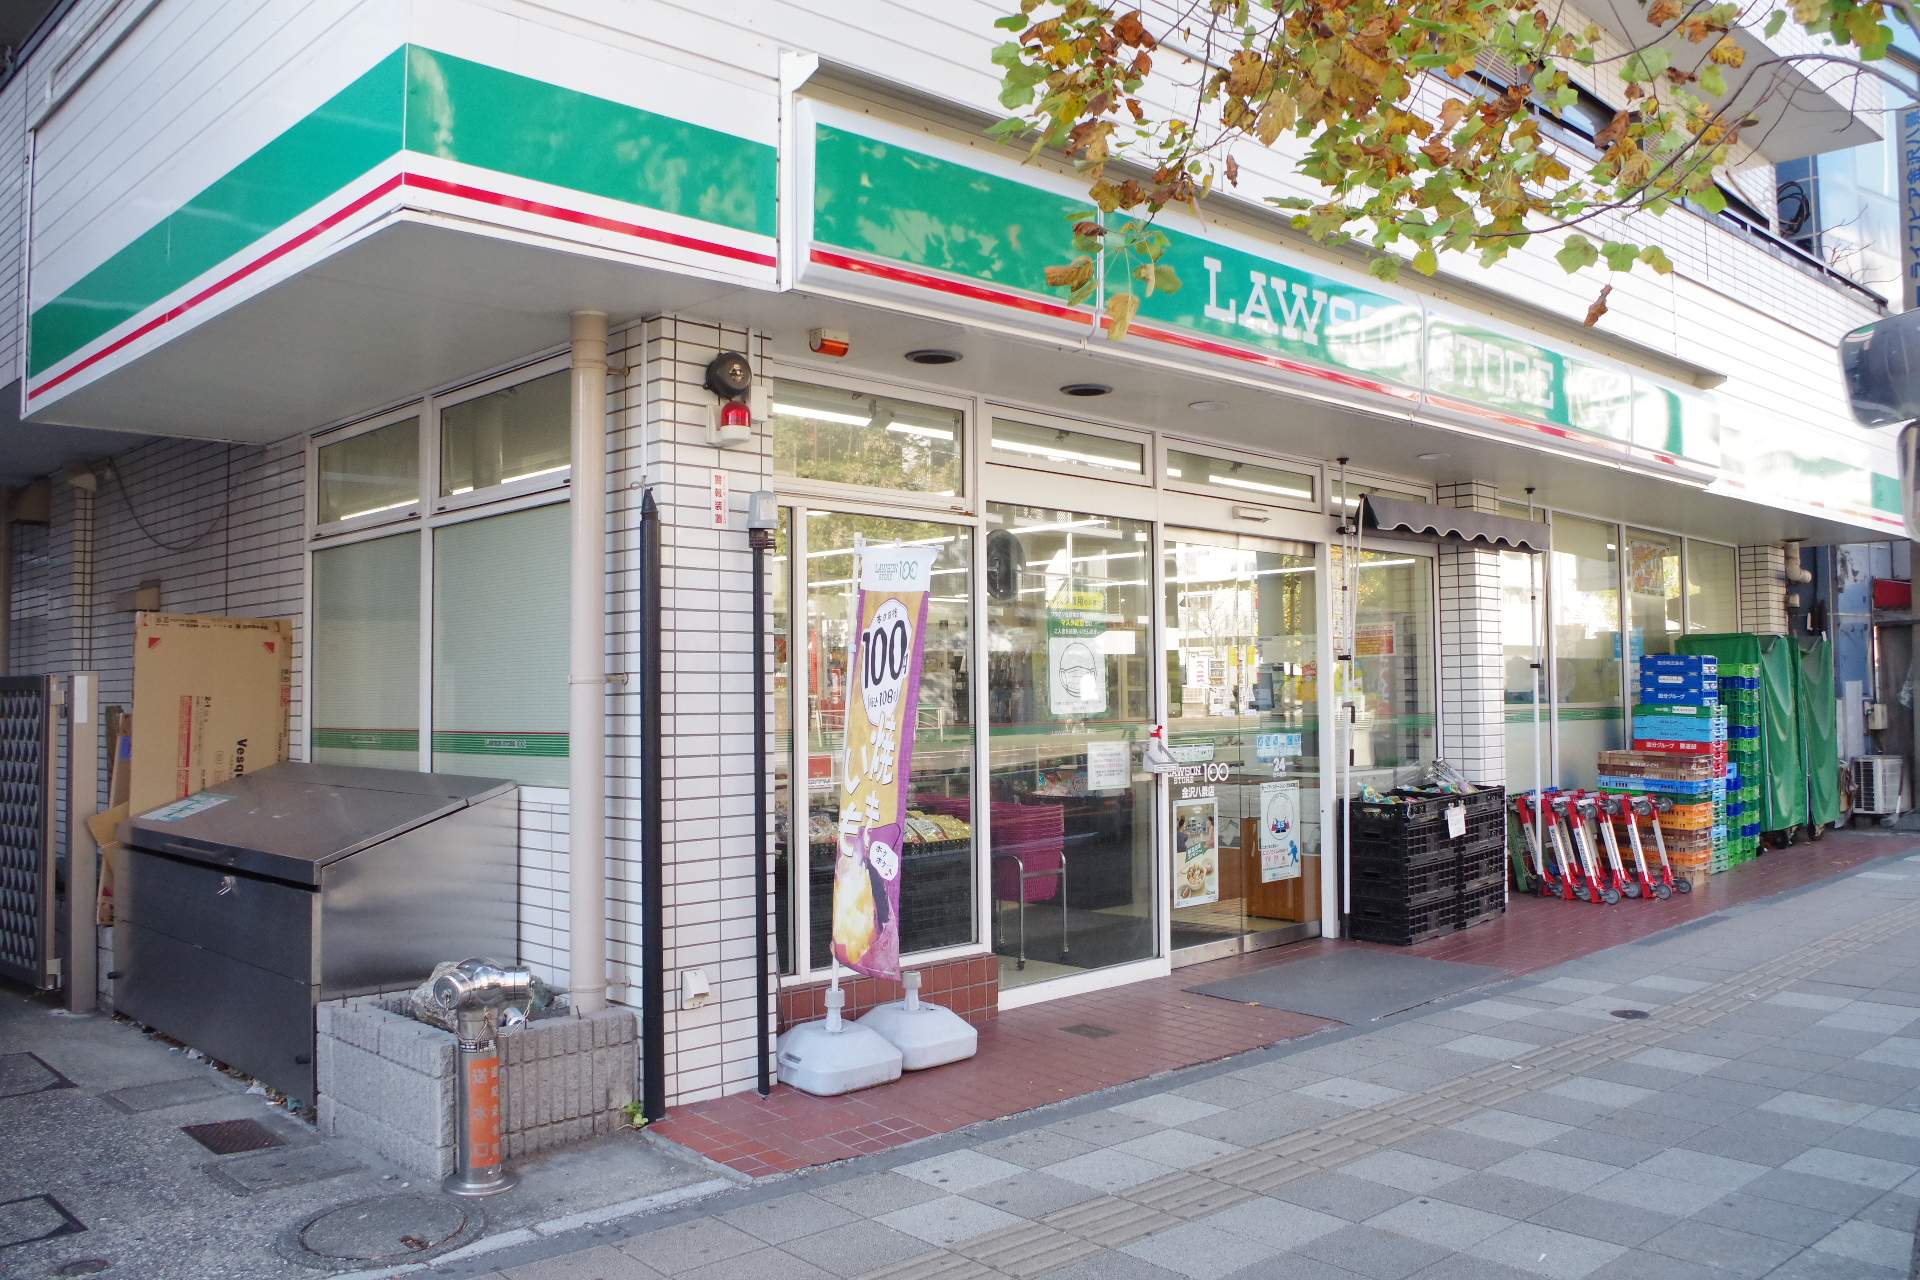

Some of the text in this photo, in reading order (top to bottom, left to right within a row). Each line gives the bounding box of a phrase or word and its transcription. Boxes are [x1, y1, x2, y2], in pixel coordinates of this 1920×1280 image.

[1203, 256, 1555, 410] LAWS TORE
[899, 560, 919, 581] 100
[864, 711, 896, 849] 焼き
[1173, 776, 1194, 784] STORE
[1202, 763, 1229, 782] 100
[839, 744, 869, 857] いも
[1181, 785, 1215, 799] 金沢八景店
